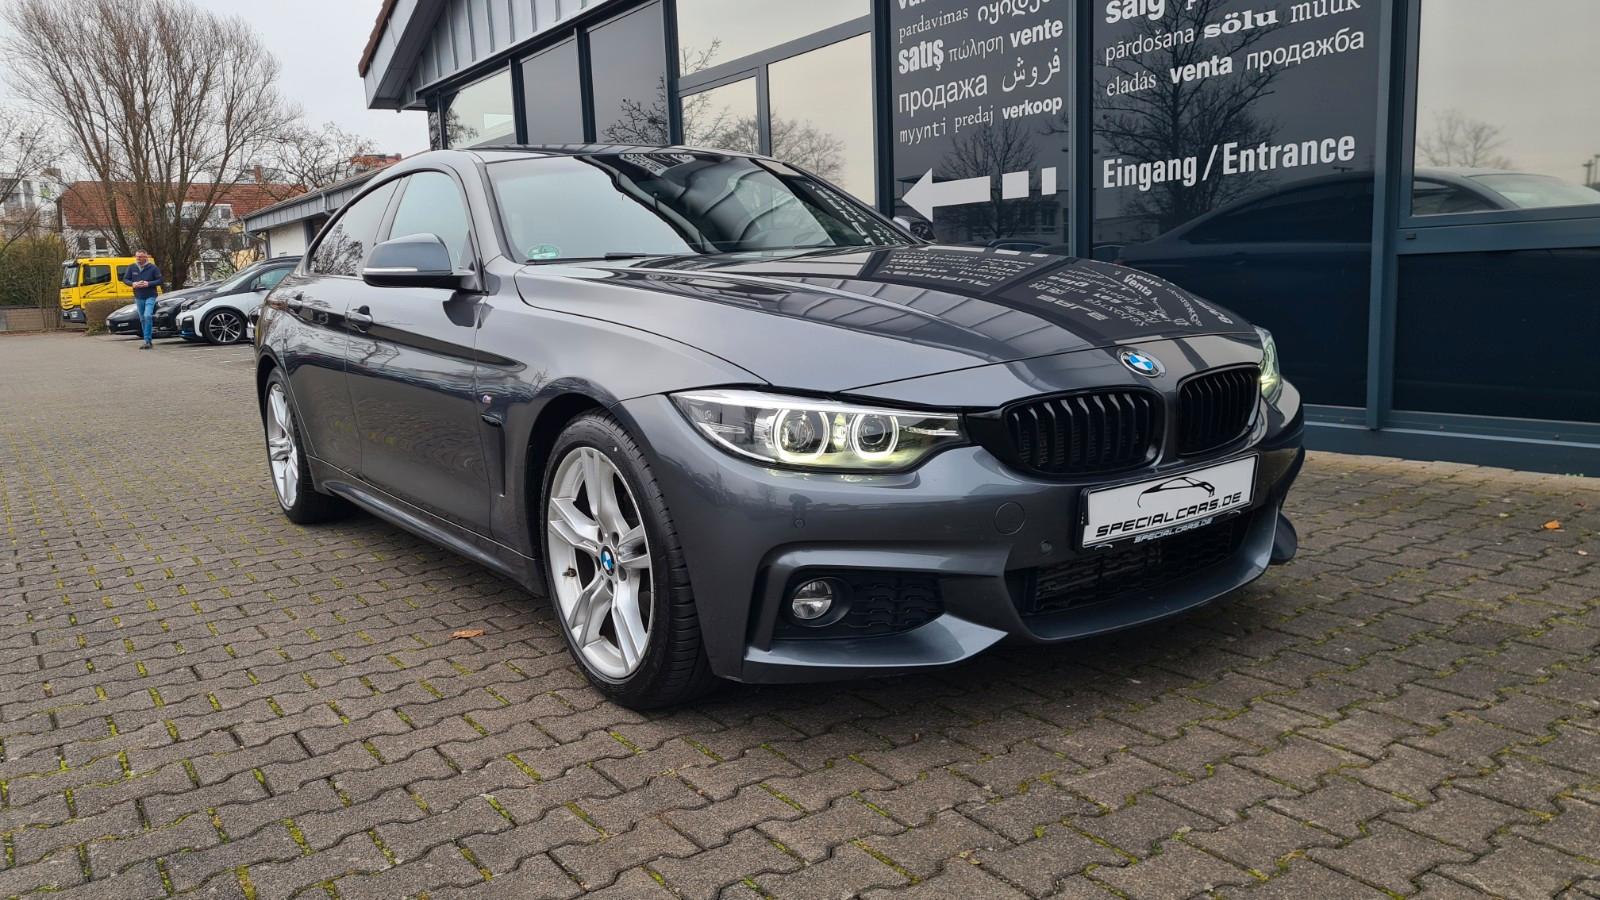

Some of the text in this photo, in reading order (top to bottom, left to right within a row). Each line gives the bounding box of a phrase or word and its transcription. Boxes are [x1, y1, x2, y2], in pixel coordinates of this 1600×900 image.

[898, 18, 1064, 74] satış πώληση vente
[899, 8, 968, 44] pardavimas
[1106, 28, 1194, 66] pārdošana
[1204, 10, 1279, 39] sölu
[899, 48, 1060, 117] продажа فروش
[1107, 27, 1364, 96] eladás venta продажба
[900, 97, 1062, 145] myynti predaj verkoop
[1104, 157, 1197, 191] Eingang
[1223, 136, 1355, 174] Entrance
[1096, 491, 1242, 537] SPECIALCARS.DE
